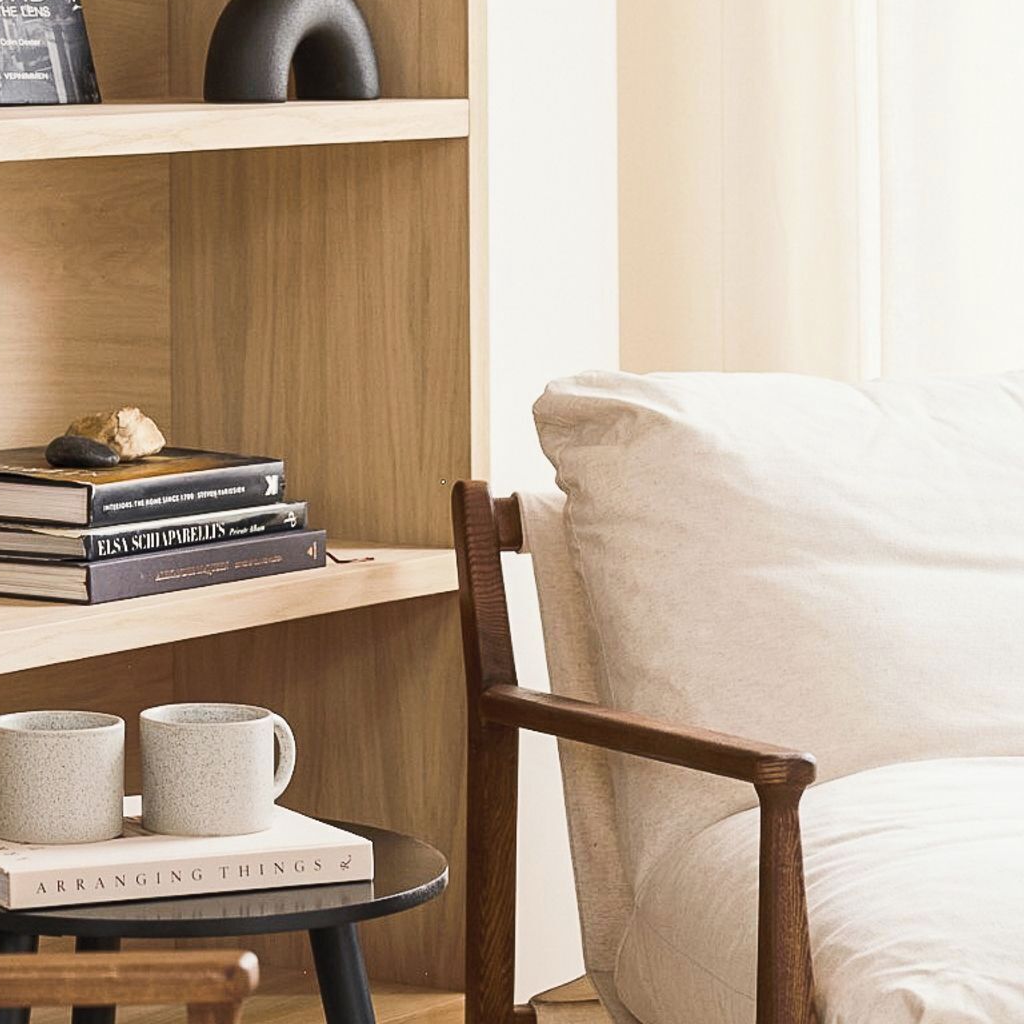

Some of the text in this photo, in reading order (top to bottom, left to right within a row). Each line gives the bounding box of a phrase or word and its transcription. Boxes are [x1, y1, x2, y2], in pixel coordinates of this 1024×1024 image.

[19, 5, 51, 18] LENS
[97, 537, 129, 557] ELSA
[131, 521, 226, 551] SCHIAPARELLI'S
[228, 527, 248, 536] Private
[35, 866, 204, 895] ARRANGING
[217, 859, 324, 879] THINGS
